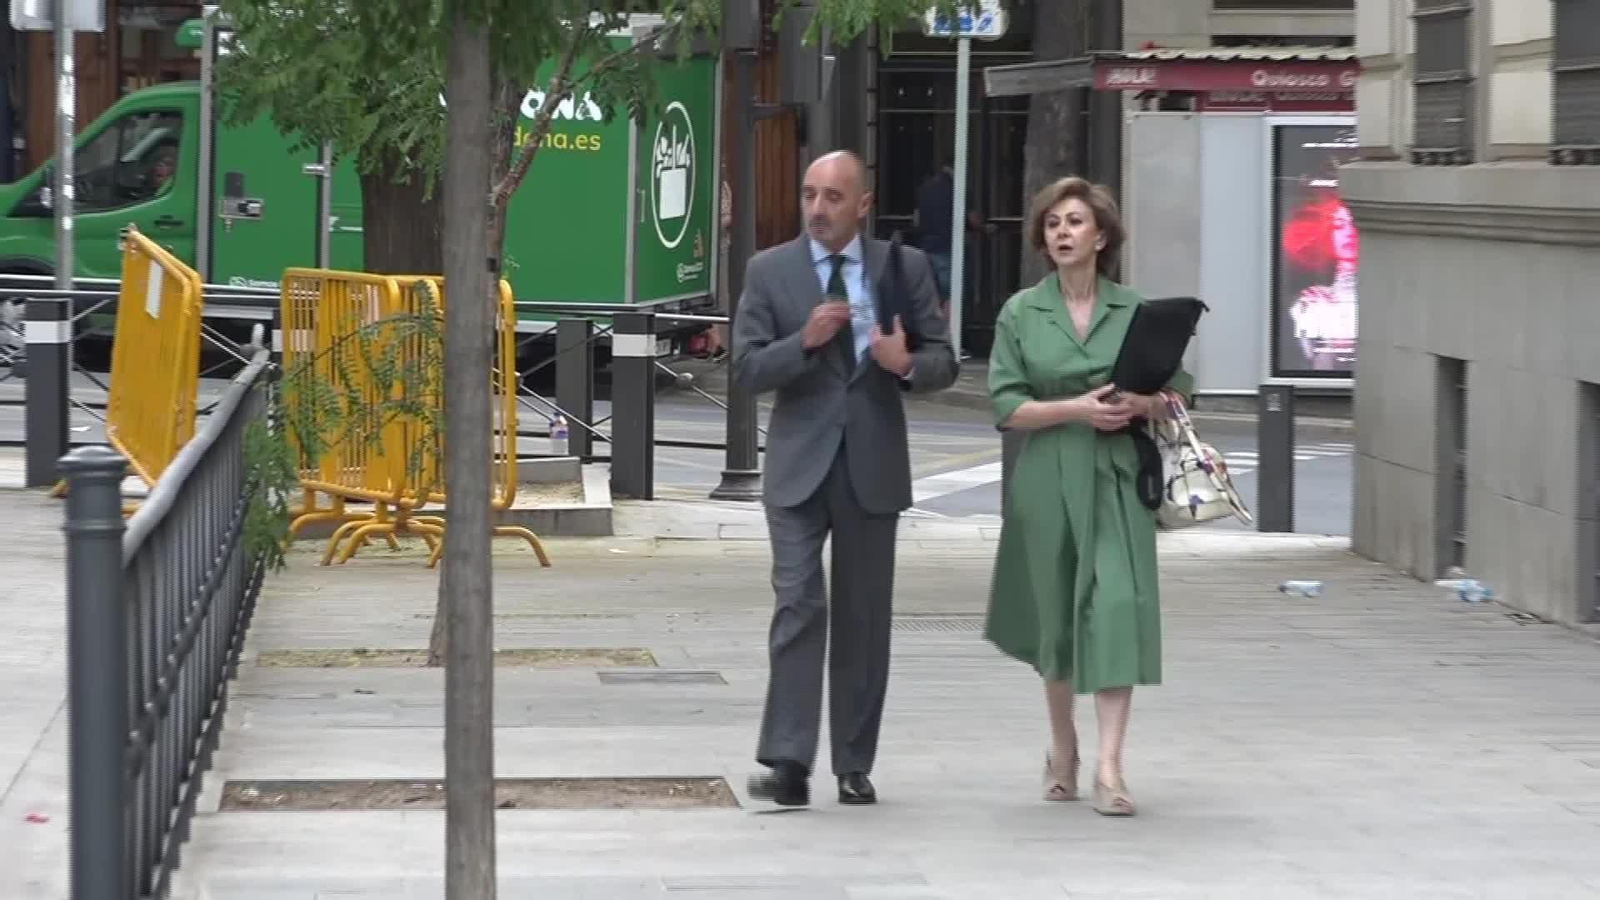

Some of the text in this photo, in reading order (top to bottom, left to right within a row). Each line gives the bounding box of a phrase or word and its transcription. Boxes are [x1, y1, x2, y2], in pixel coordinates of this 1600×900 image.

[1251, 69, 1331, 87] Quiosco
[1339, 69, 1357, 87] G
[520, 88, 603, 121] ONA
